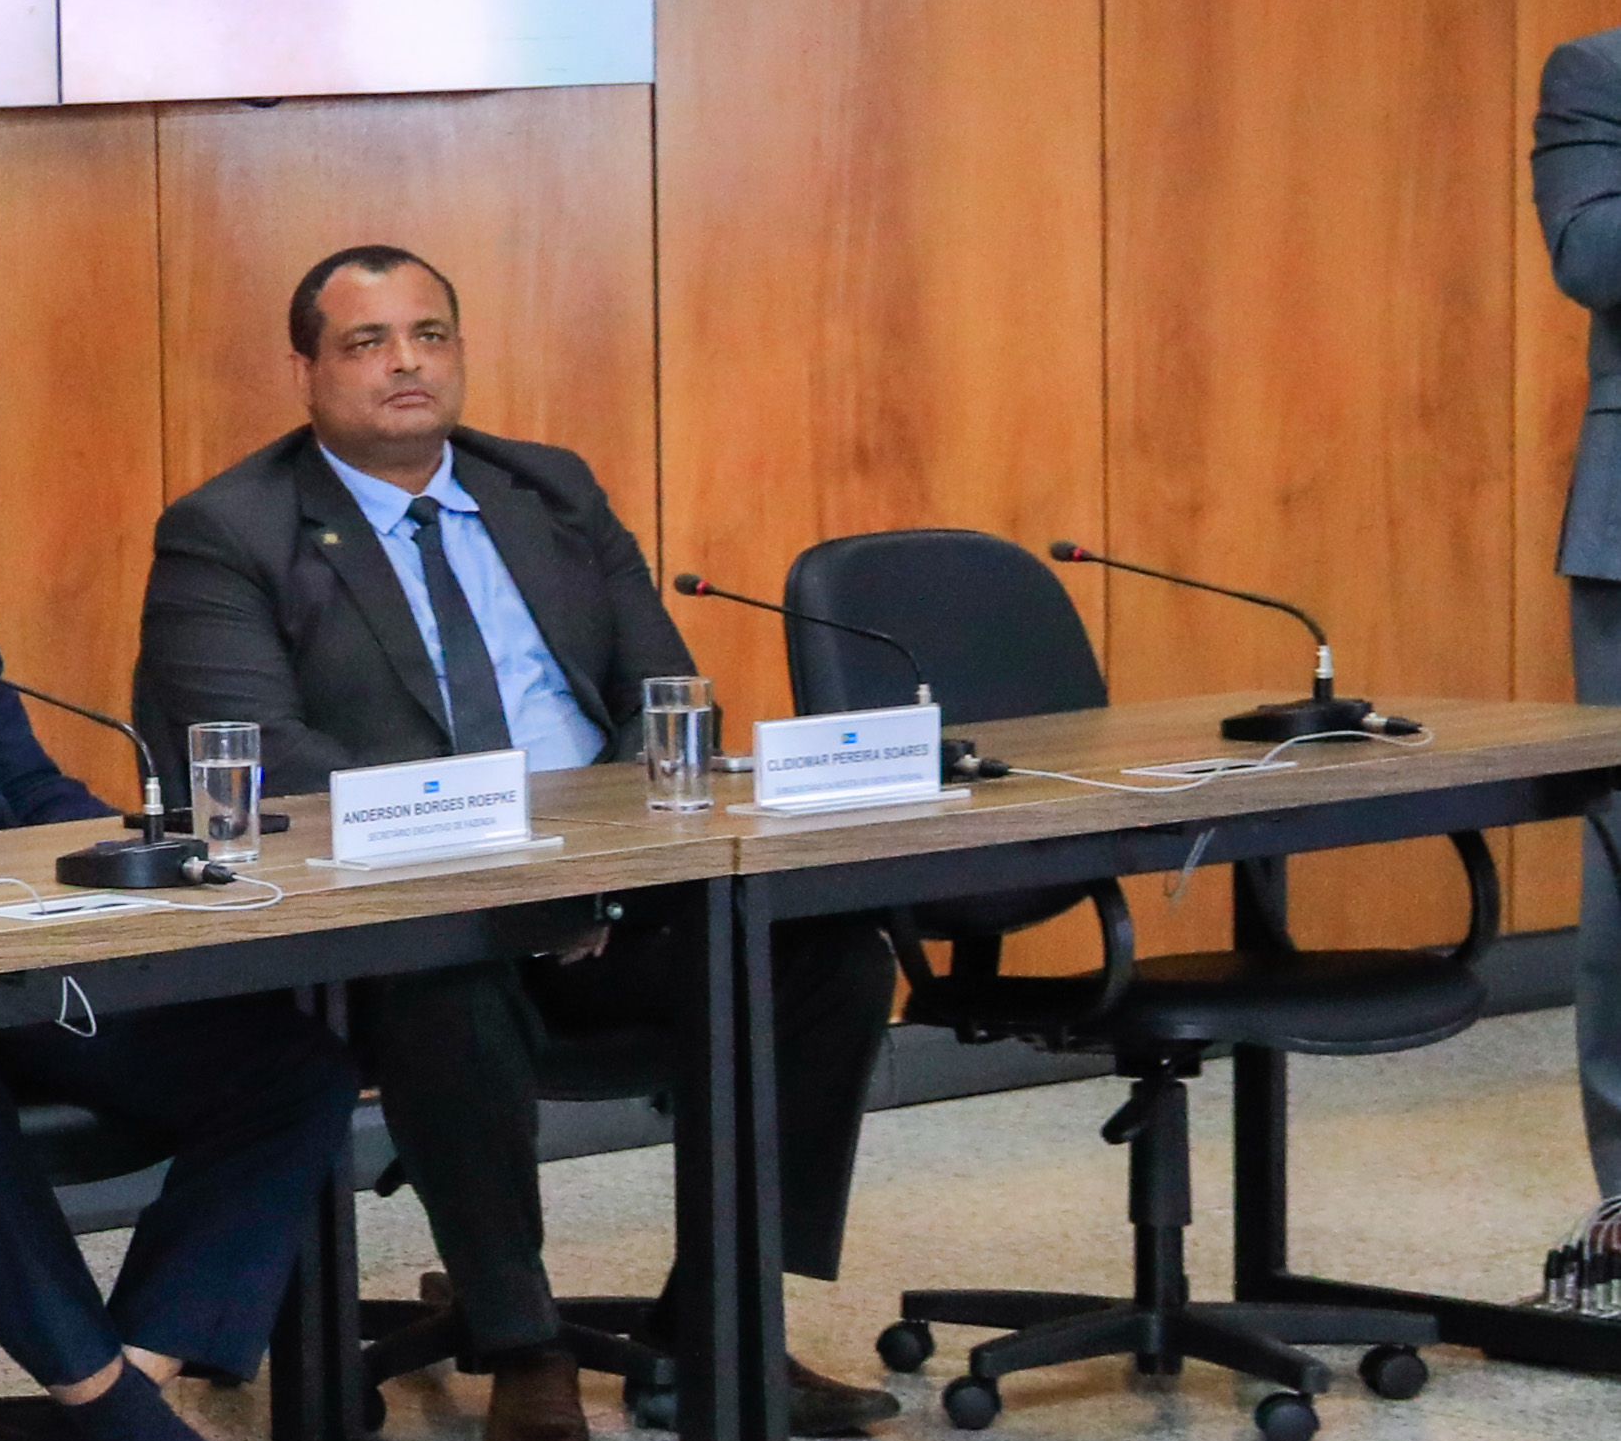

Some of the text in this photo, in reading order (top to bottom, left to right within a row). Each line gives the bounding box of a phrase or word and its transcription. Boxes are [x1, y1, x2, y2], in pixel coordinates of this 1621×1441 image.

[883, 743, 929, 760] SOARES
[343, 790, 517, 825] ANDERSON BORGES ROEPKE
